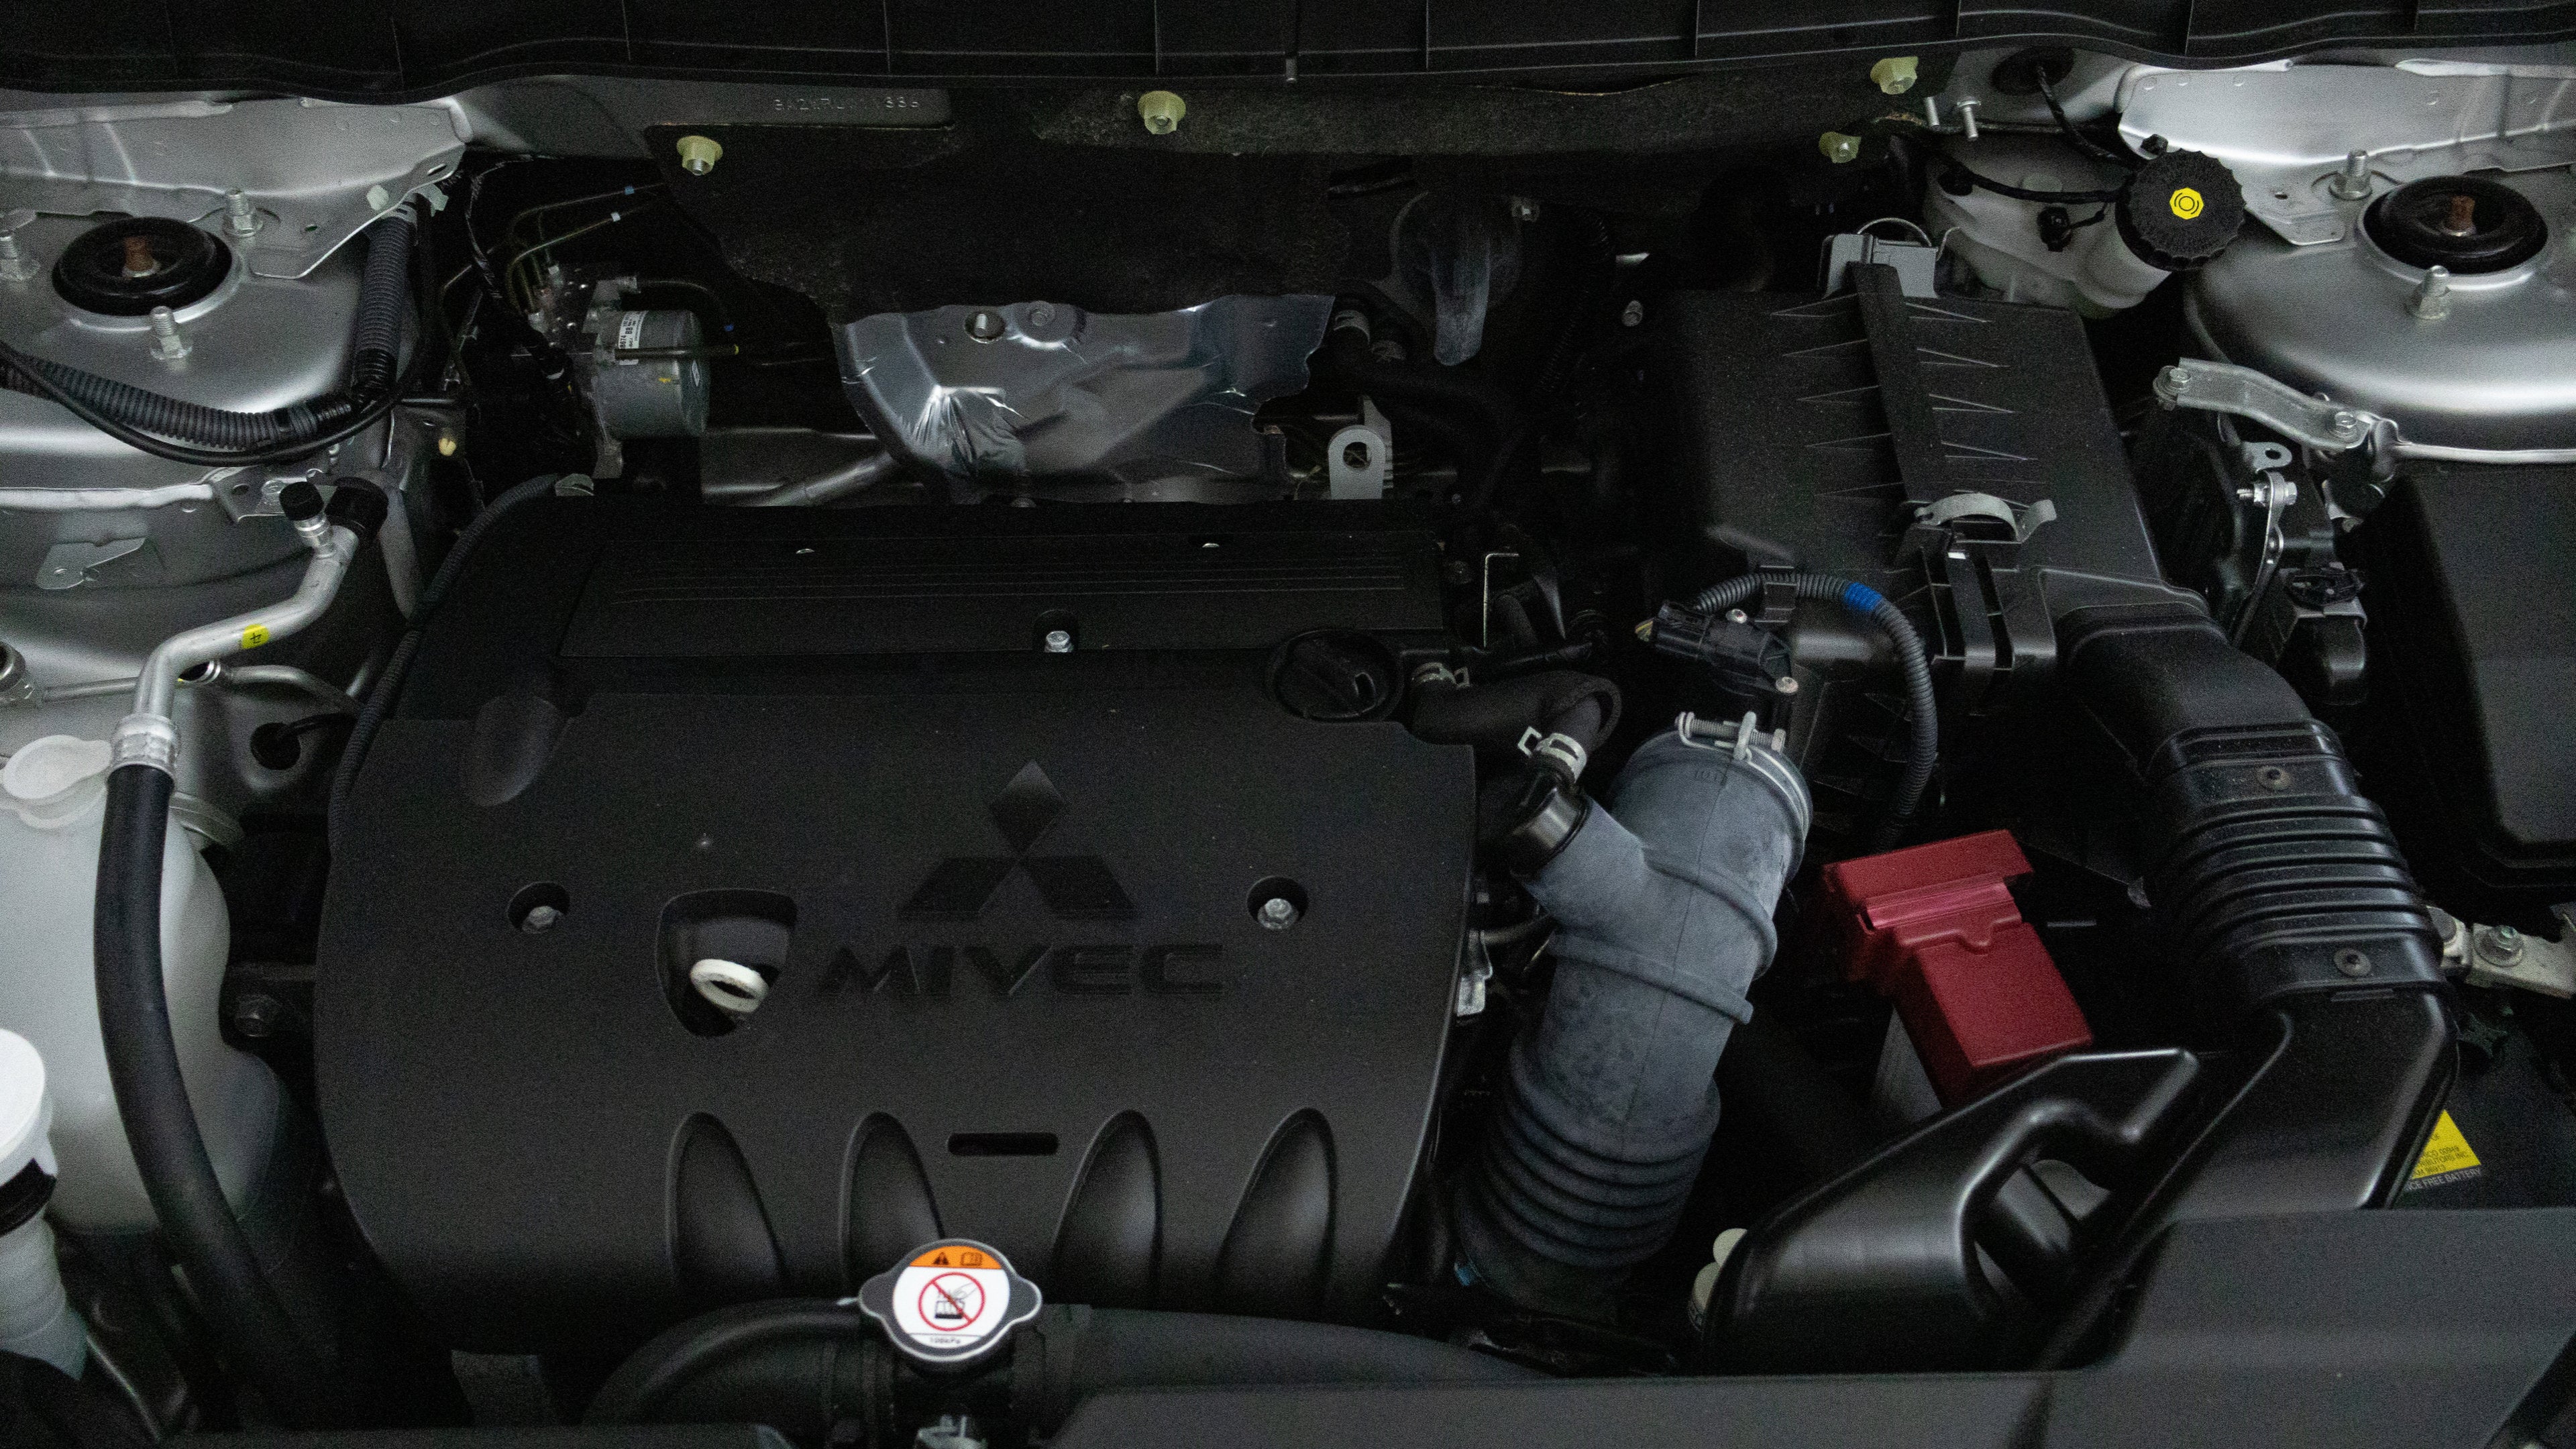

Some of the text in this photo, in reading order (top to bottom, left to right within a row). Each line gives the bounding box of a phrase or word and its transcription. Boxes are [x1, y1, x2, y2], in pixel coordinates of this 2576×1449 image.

[816, 943, 1224, 996] MIVEC
[2422, 1173, 2445, 1187] FREE
[2444, 1167, 2482, 1182] BATTERY
